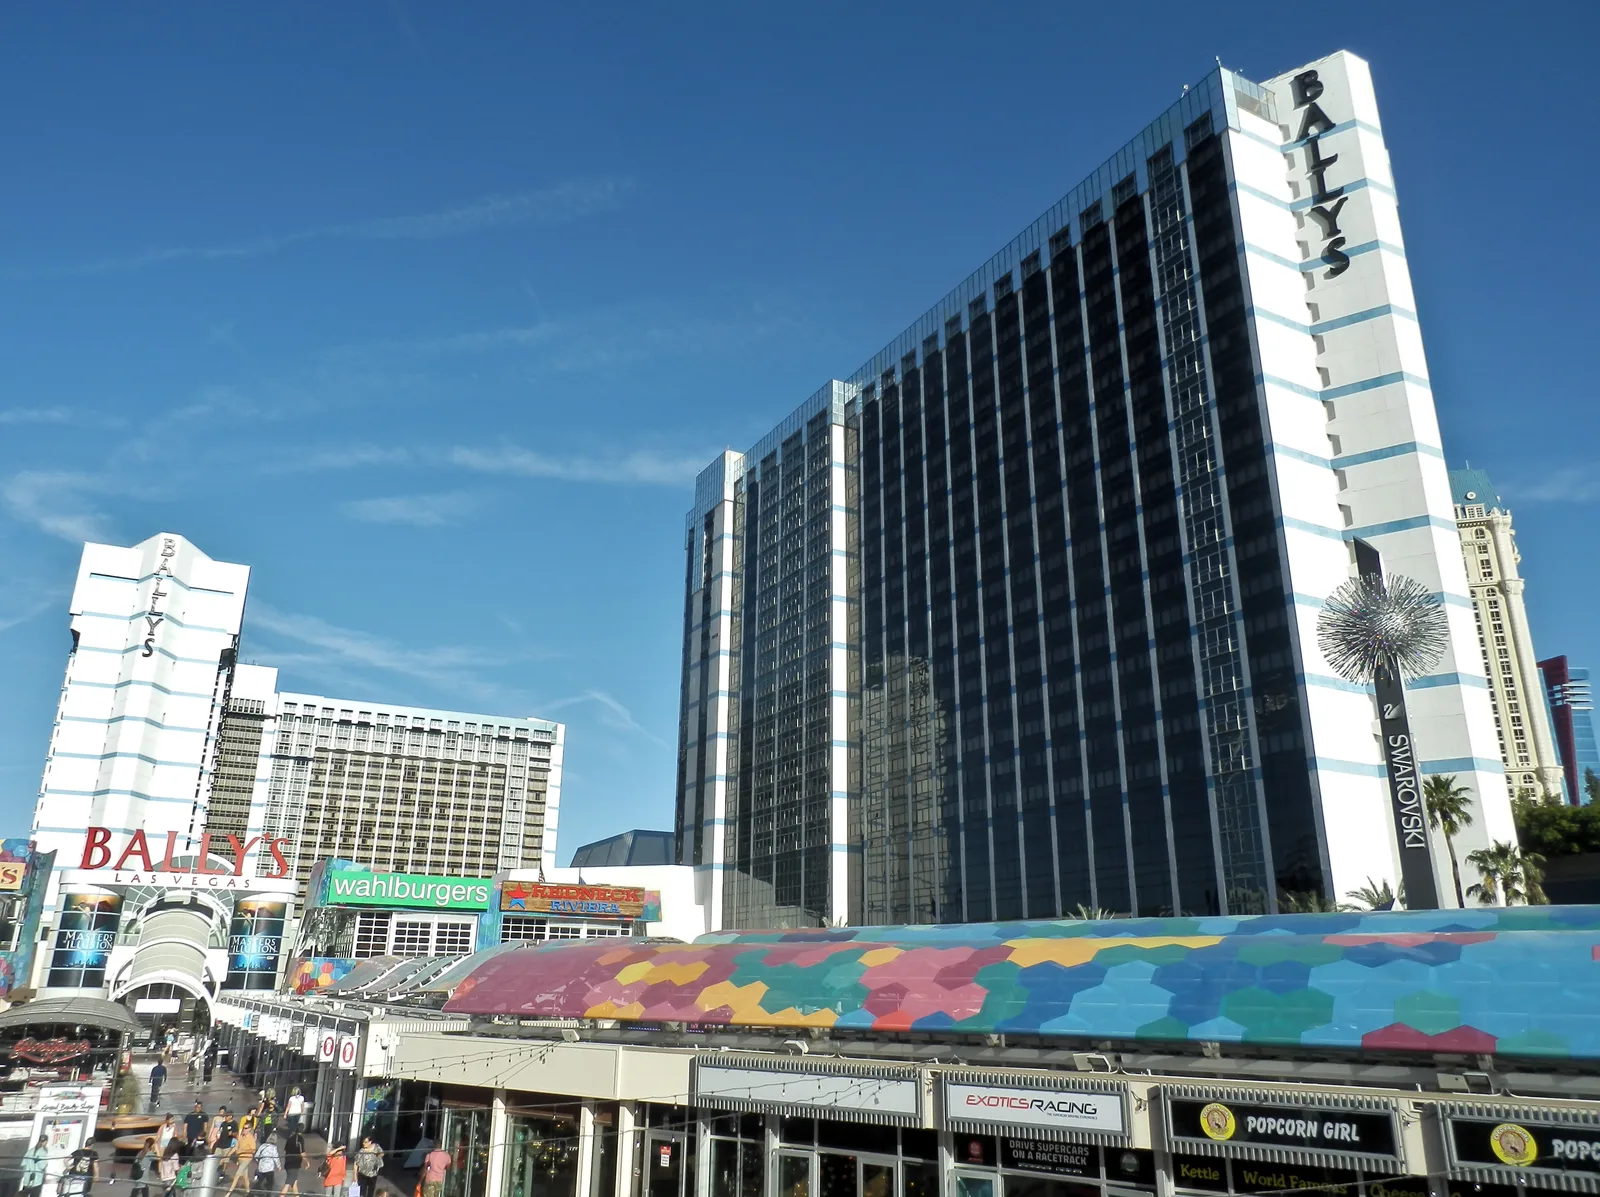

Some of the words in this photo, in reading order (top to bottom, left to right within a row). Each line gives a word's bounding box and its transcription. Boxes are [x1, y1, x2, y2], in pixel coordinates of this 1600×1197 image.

[1388, 734, 1426, 849] SWAROVSKI
[79, 826, 290, 879] BALLY'S
[115, 873, 157, 884] LAS
[173, 875, 250, 888] VEGAS
[334, 875, 488, 907] wahlburgers
[531, 884, 640, 903] REDNECK
[550, 900, 620, 913] RIVIERA
[232, 936, 276, 946] MASERS
[233, 945, 278, 954] ILLUION
[1247, 1115, 1318, 1138] POPCORN
[1323, 1121, 1360, 1142] GIRL
[1009, 1140, 1035, 1150] DRIVE
[1037, 1143, 1089, 1156] SUPERCARS
[1012, 1149, 1025, 1159] ON
[1028, 1151, 1034, 1160] A
[1035, 1152, 1087, 1165] RACETRACK
[1180, 1164, 1220, 1180] Kettle
[1243, 1170, 1287, 1188] World
[1289, 1175, 1348, 1194] Famous
